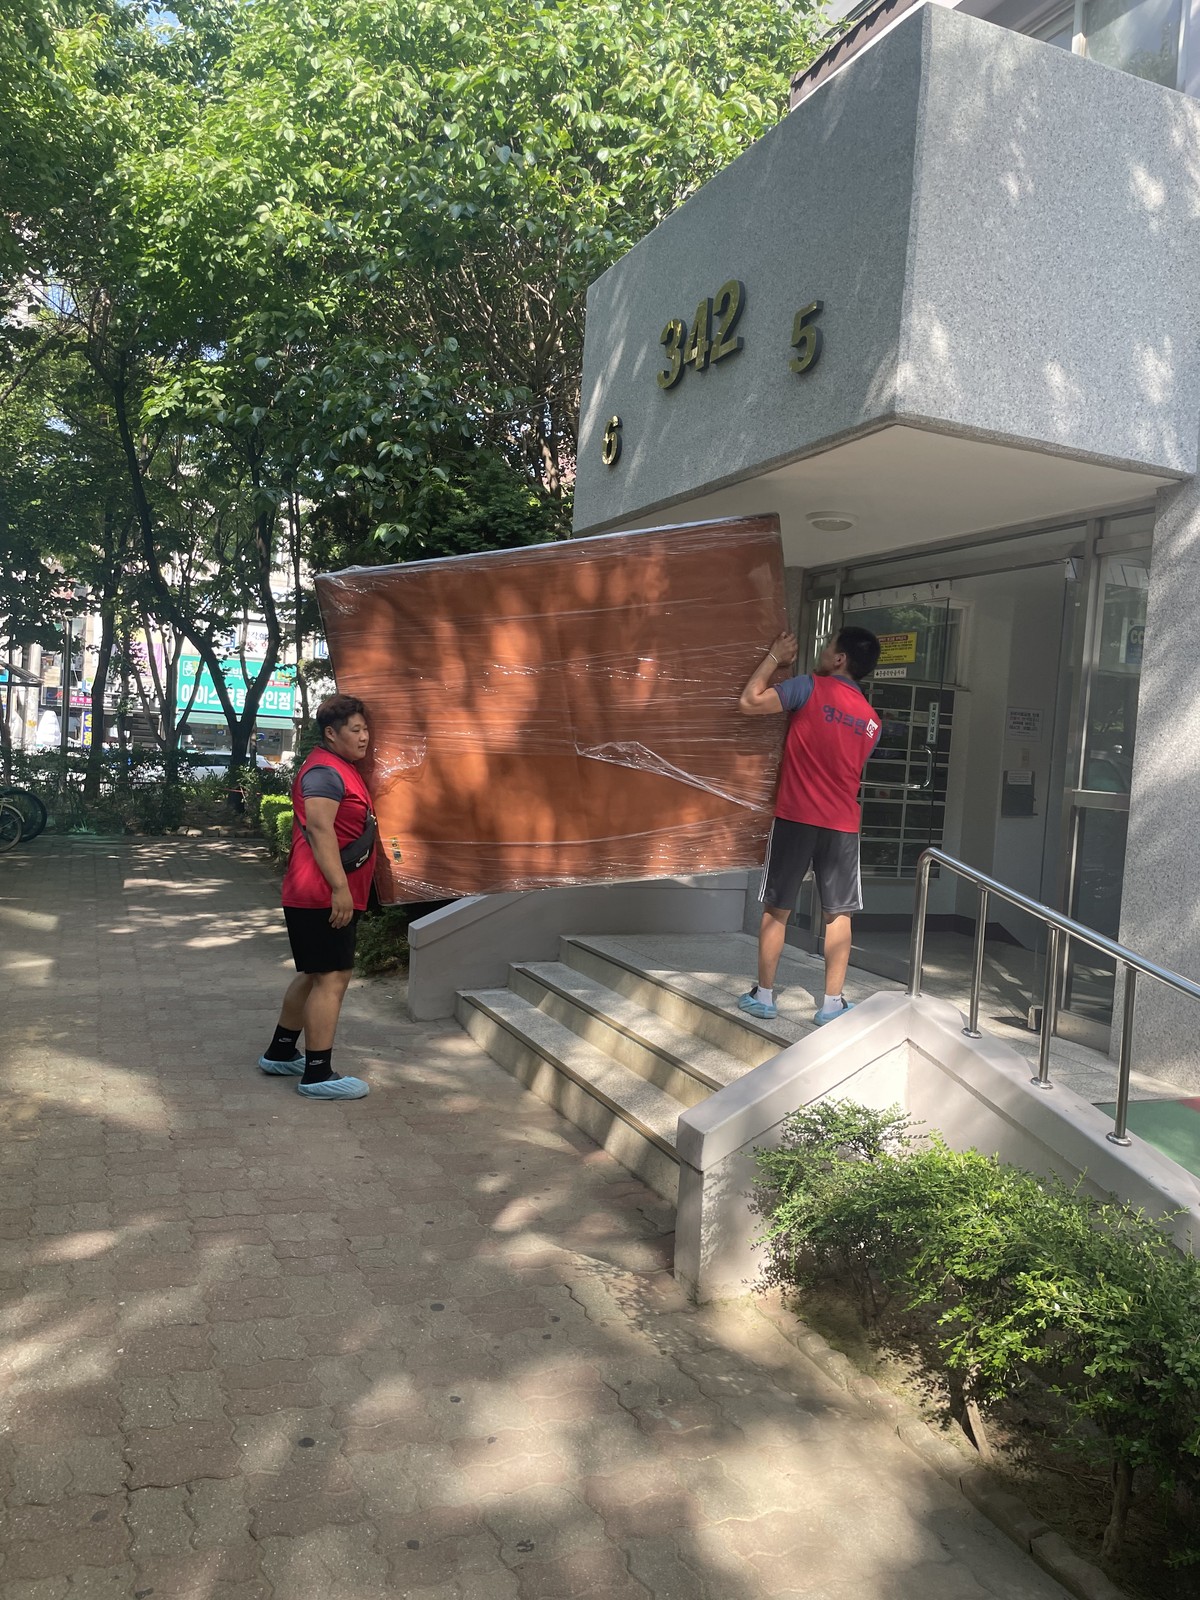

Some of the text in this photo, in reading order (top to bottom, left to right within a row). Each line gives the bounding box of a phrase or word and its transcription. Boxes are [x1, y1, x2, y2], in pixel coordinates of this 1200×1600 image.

[656, 279, 746, 390] 342
[788, 300, 824, 374] 5
[601, 415, 622, 465] 6
[823, 704, 866, 736] 영구크린
